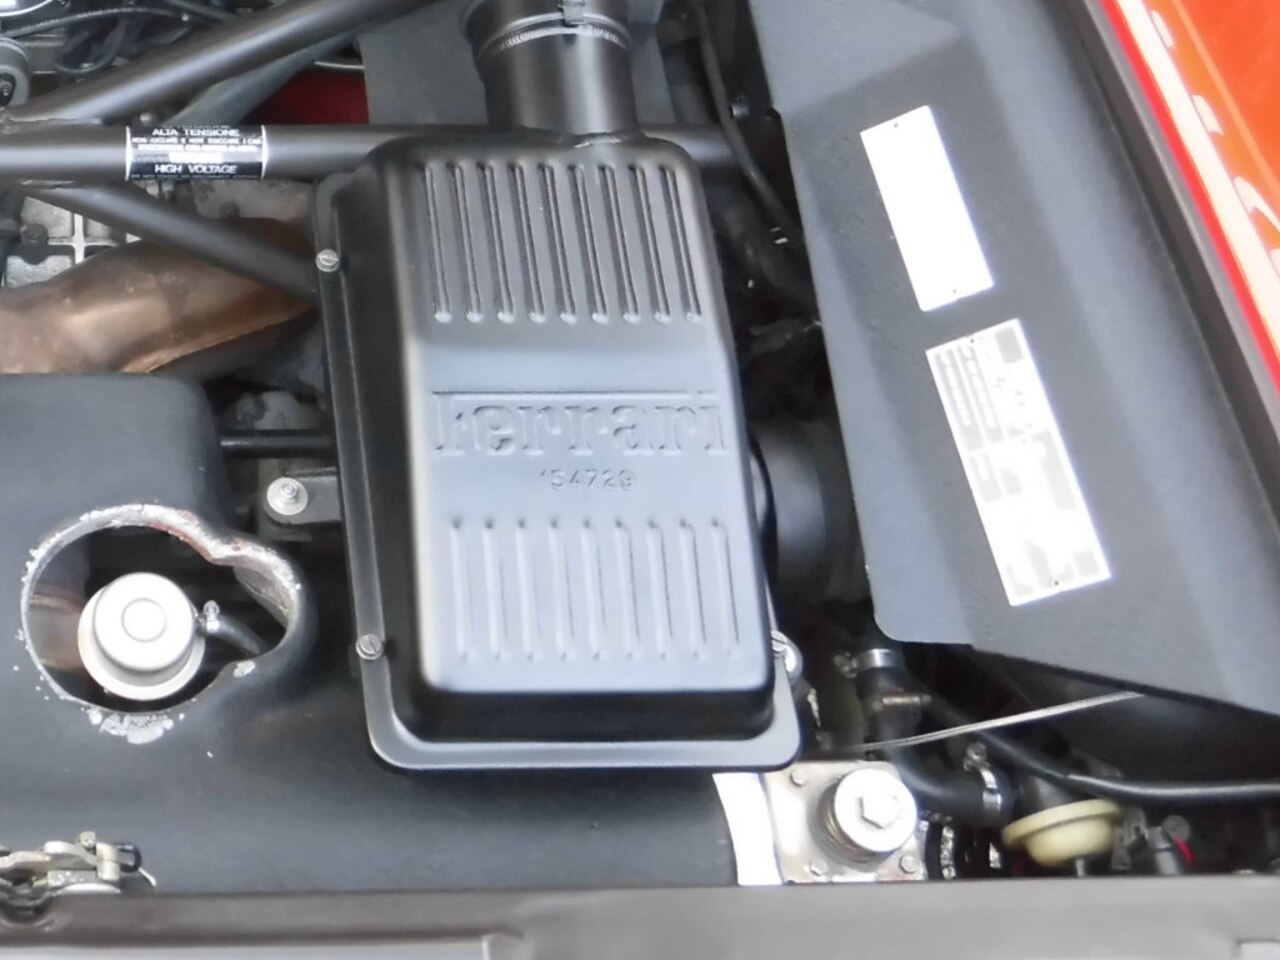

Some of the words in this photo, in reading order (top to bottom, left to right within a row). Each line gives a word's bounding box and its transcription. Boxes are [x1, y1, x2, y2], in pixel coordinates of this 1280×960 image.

[152, 128, 179, 137] ALTA
[184, 128, 240, 137] TENSIONE
[154, 164, 183, 174] HIGH
[188, 164, 238, 174] VOLTAGE
[433, 391, 727, 456] Ferrari
